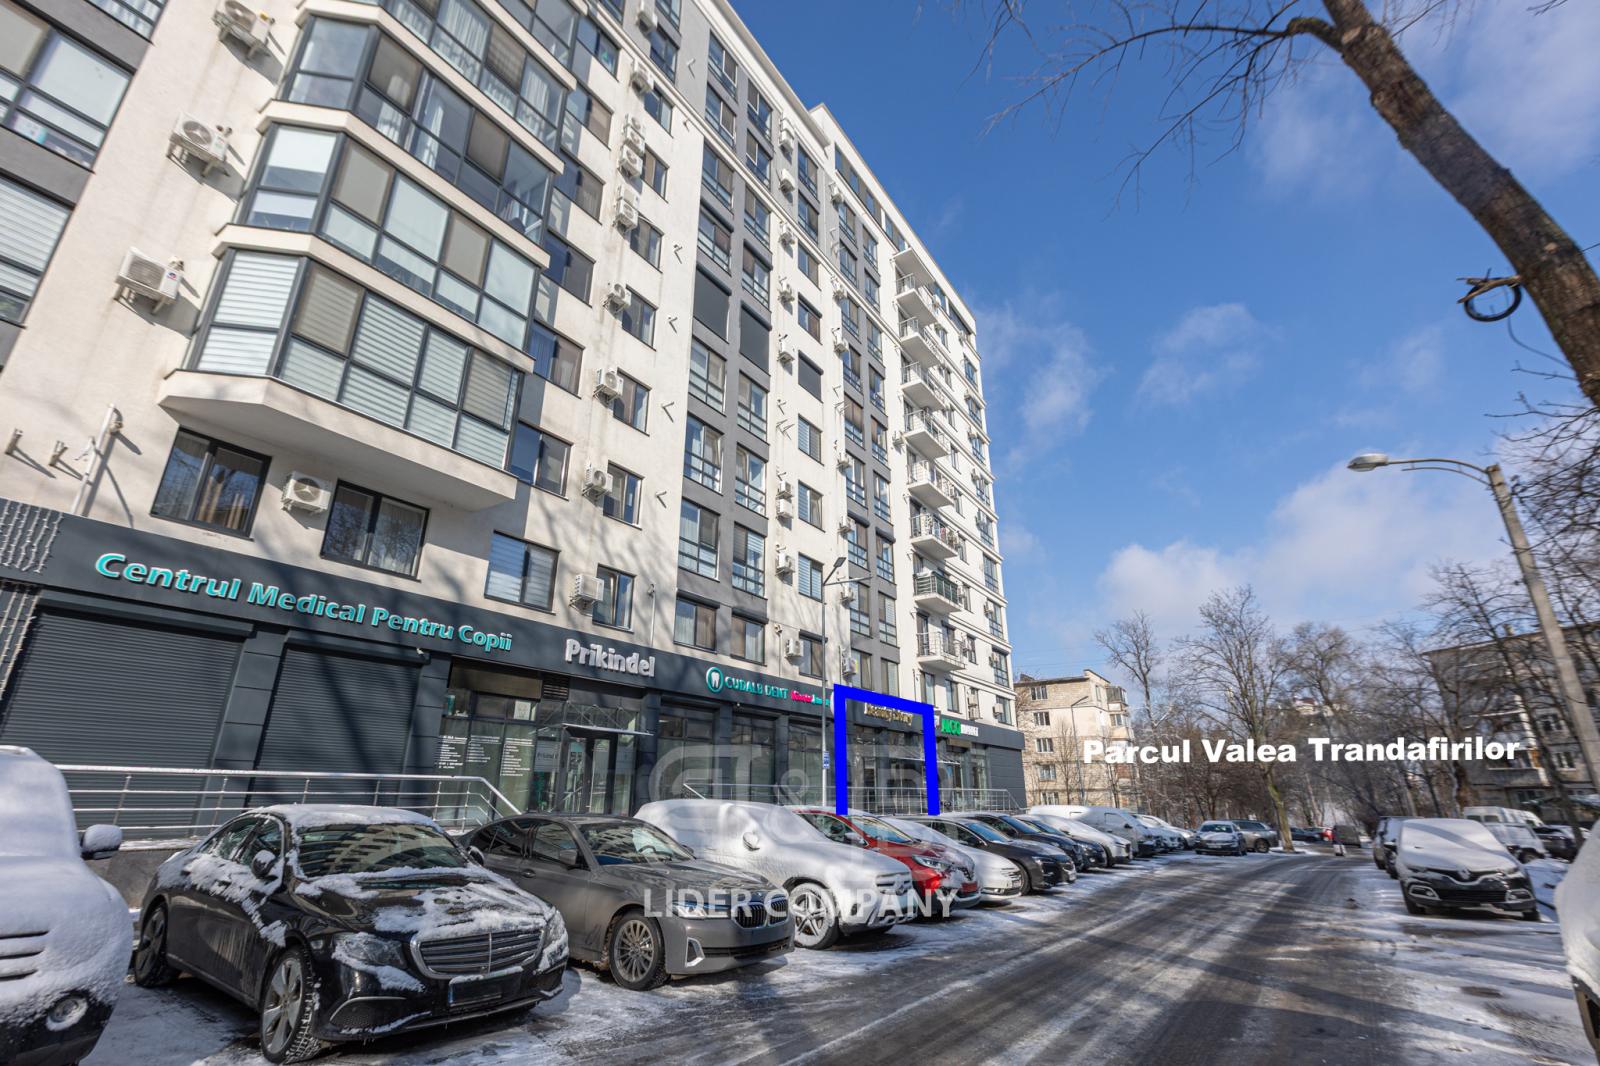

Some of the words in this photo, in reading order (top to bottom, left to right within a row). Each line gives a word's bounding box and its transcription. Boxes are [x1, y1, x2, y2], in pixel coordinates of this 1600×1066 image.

[95, 553, 241, 600] Centrul
[247, 582, 366, 624] Medical
[371, 607, 454, 640] Pentru
[458, 625, 513, 651] Copii
[565, 638, 655, 678] Prikindel
[765, 684, 788, 699] DENT
